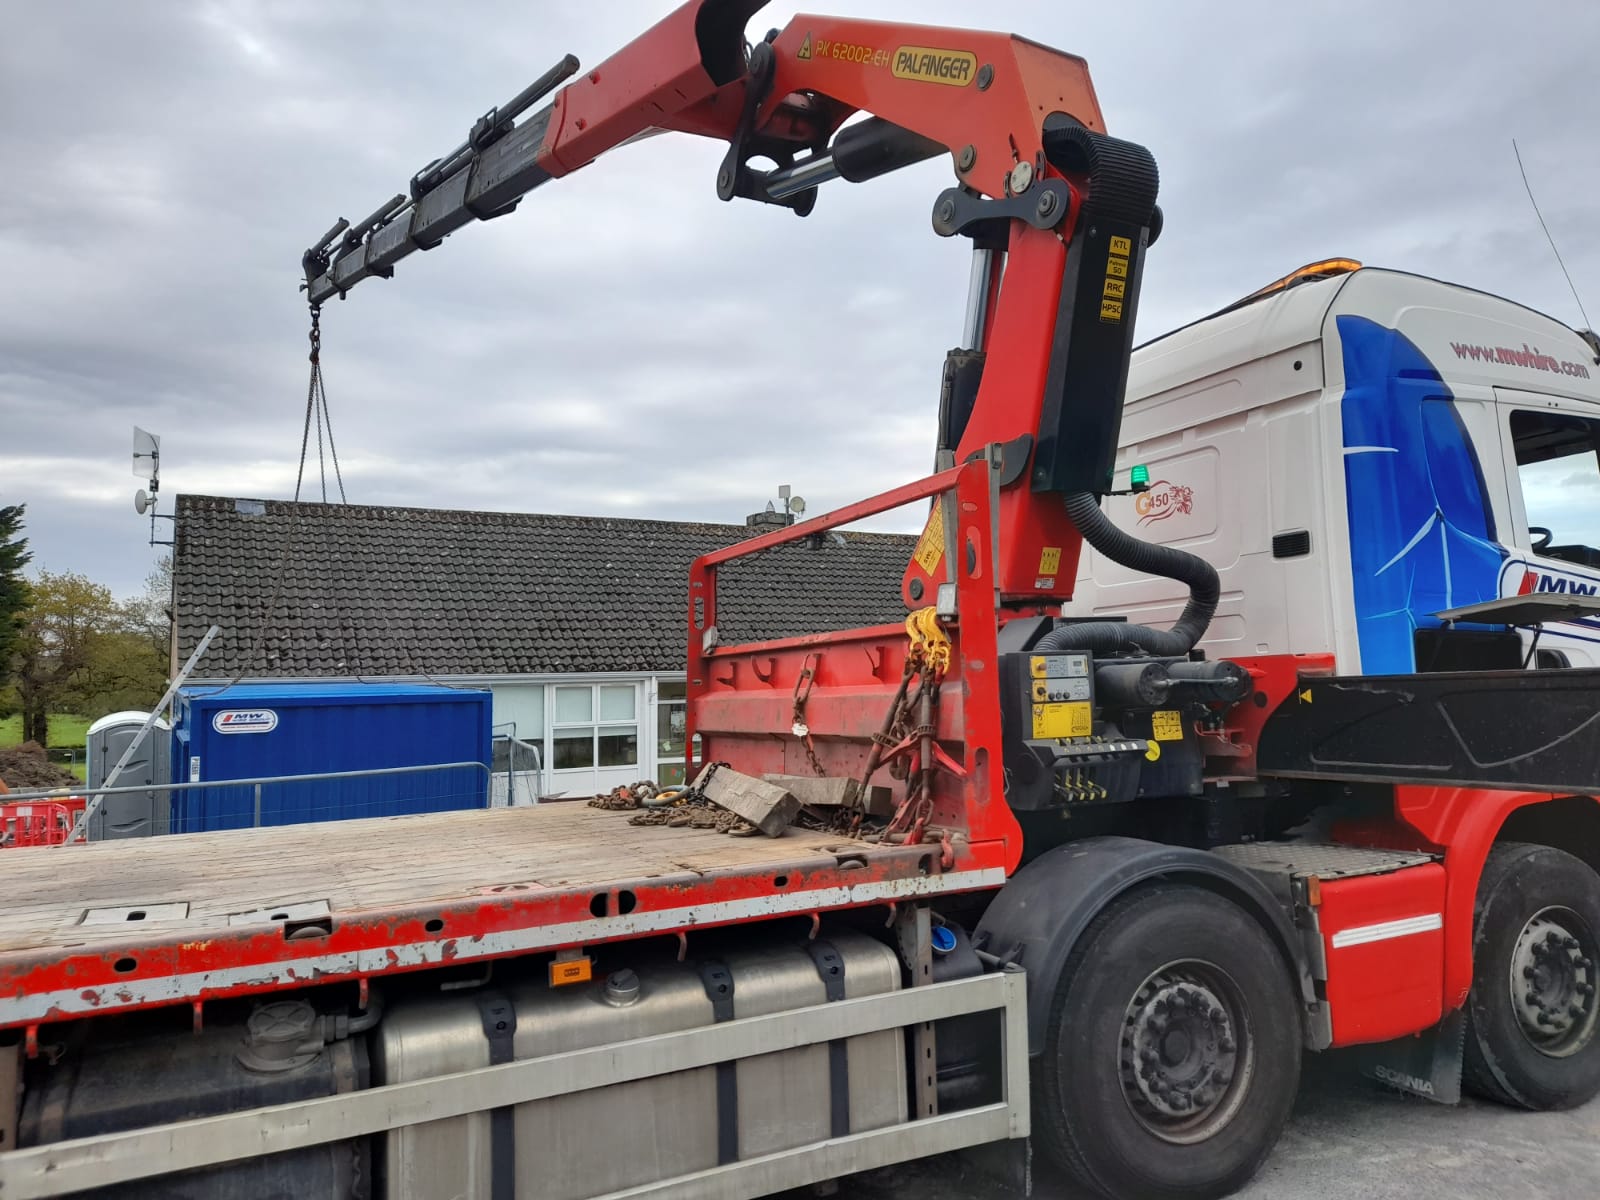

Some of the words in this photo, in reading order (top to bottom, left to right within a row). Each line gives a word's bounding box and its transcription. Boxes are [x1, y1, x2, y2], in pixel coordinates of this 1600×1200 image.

[815, 40, 831, 57] PK
[896, 51, 972, 81] PALFINGER
[1113, 240, 1127, 250] KTL
[1450, 341, 1591, 380] www.mwhire.com
[1538, 574, 1598, 596] MW
